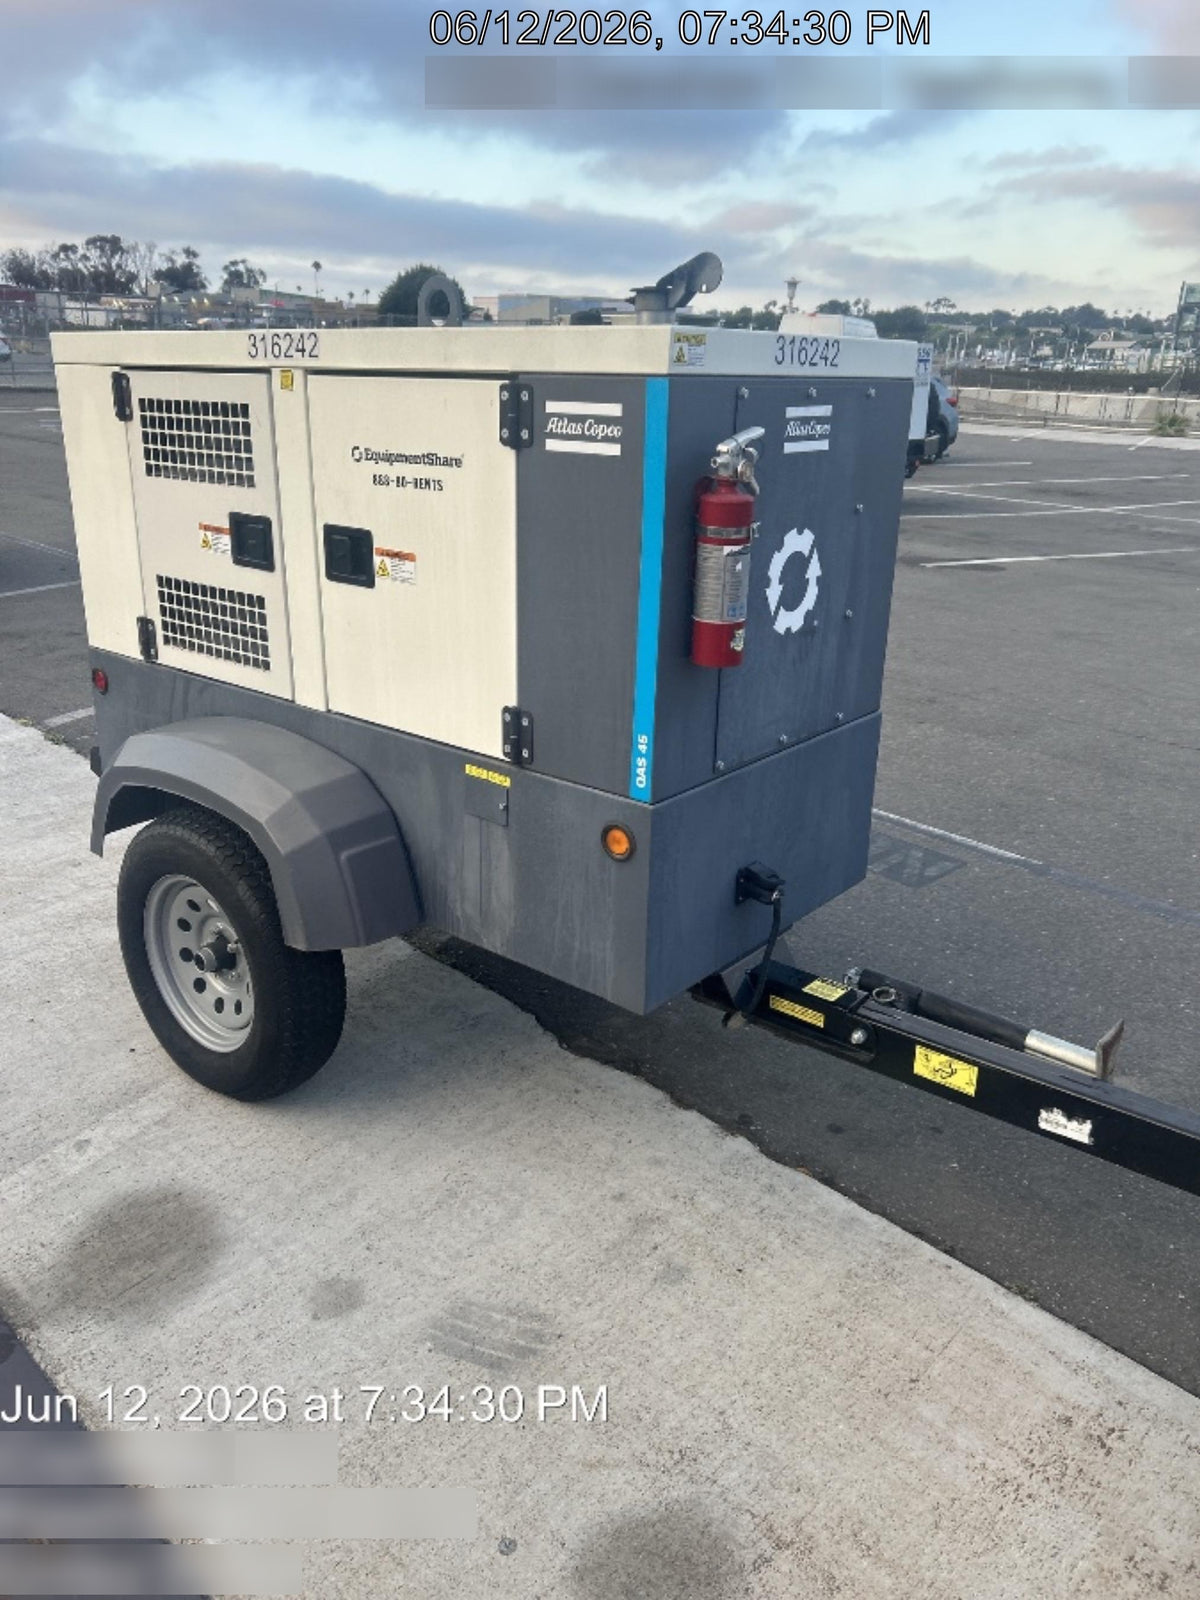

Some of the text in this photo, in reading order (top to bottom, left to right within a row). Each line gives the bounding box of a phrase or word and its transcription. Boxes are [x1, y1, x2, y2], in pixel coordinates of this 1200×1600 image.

[248, 332, 319, 358] 316242
[774, 335, 840, 367] 316242
[544, 417, 622, 440] Atlas Copco
[364, 447, 462, 468] EquipmentShare
[637, 734, 648, 755] 45
